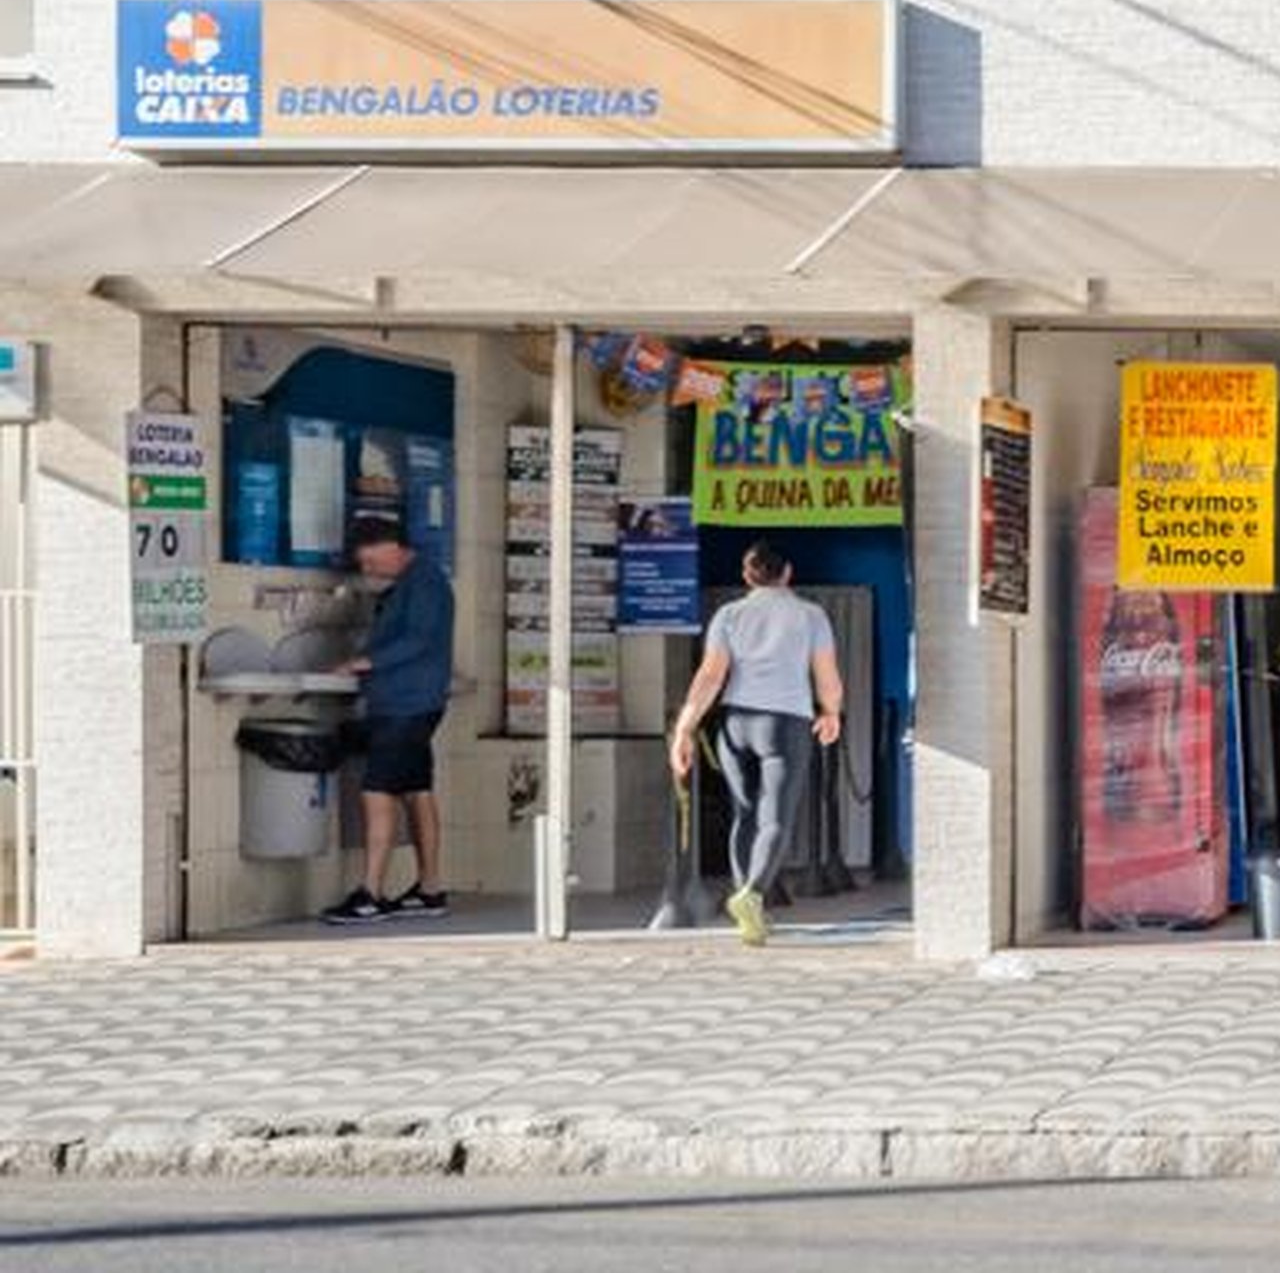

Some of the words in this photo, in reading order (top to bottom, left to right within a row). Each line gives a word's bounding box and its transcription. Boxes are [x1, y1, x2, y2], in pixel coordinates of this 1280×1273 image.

[134, 67, 249, 94] loterias
[135, 95, 249, 123] CAIXA
[277, 79, 479, 116] BENGALÃO
[493, 87, 659, 117] LOTERIAS
[711, 479, 725, 510] A
[736, 478, 814, 514] QUINA
[823, 476, 854, 508] DA
[1136, 490, 1258, 512] Servimos
[1139, 516, 1234, 538] Lanche
[1245, 523, 1258, 538] e
[1148, 544, 1244, 570] Almoço
